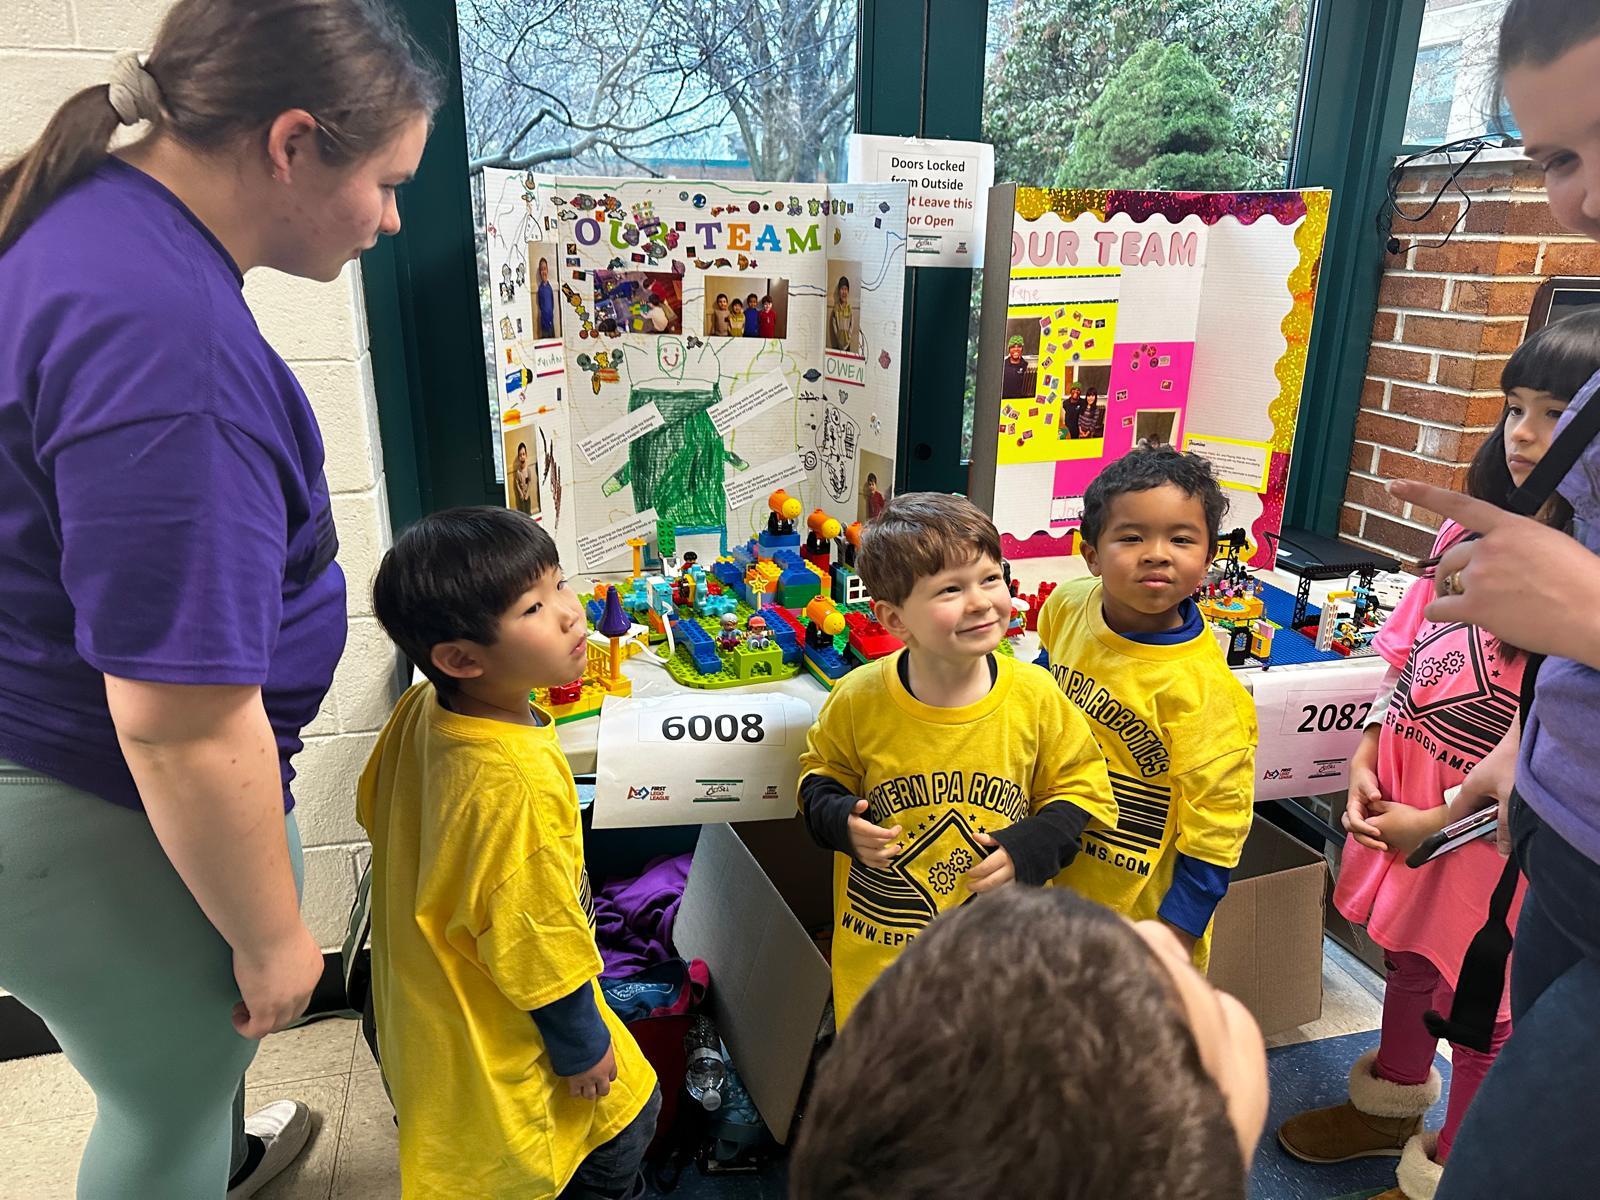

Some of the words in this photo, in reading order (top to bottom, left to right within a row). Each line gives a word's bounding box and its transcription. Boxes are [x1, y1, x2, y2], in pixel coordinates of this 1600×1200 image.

[891, 157, 924, 170] Doors
[928, 159, 965, 172] Locked
[922, 178, 964, 190] Outside
[919, 196, 949, 208] Leave
[954, 198, 973, 209] this
[924, 214, 954, 228] Open
[696, 222, 822, 254] TEAM
[1011, 230, 1080, 267] OUR
[1094, 231, 1198, 267] TEAM
[826, 357, 864, 382] OWEN
[662, 714, 765, 743] 6008
[1066, 670, 1095, 708] PA
[1085, 688, 1170, 778] ROBOTICS
[1297, 702, 1372, 732] 2082
[932, 771, 964, 804] PA
[1080, 838, 1150, 876] MS.COM
